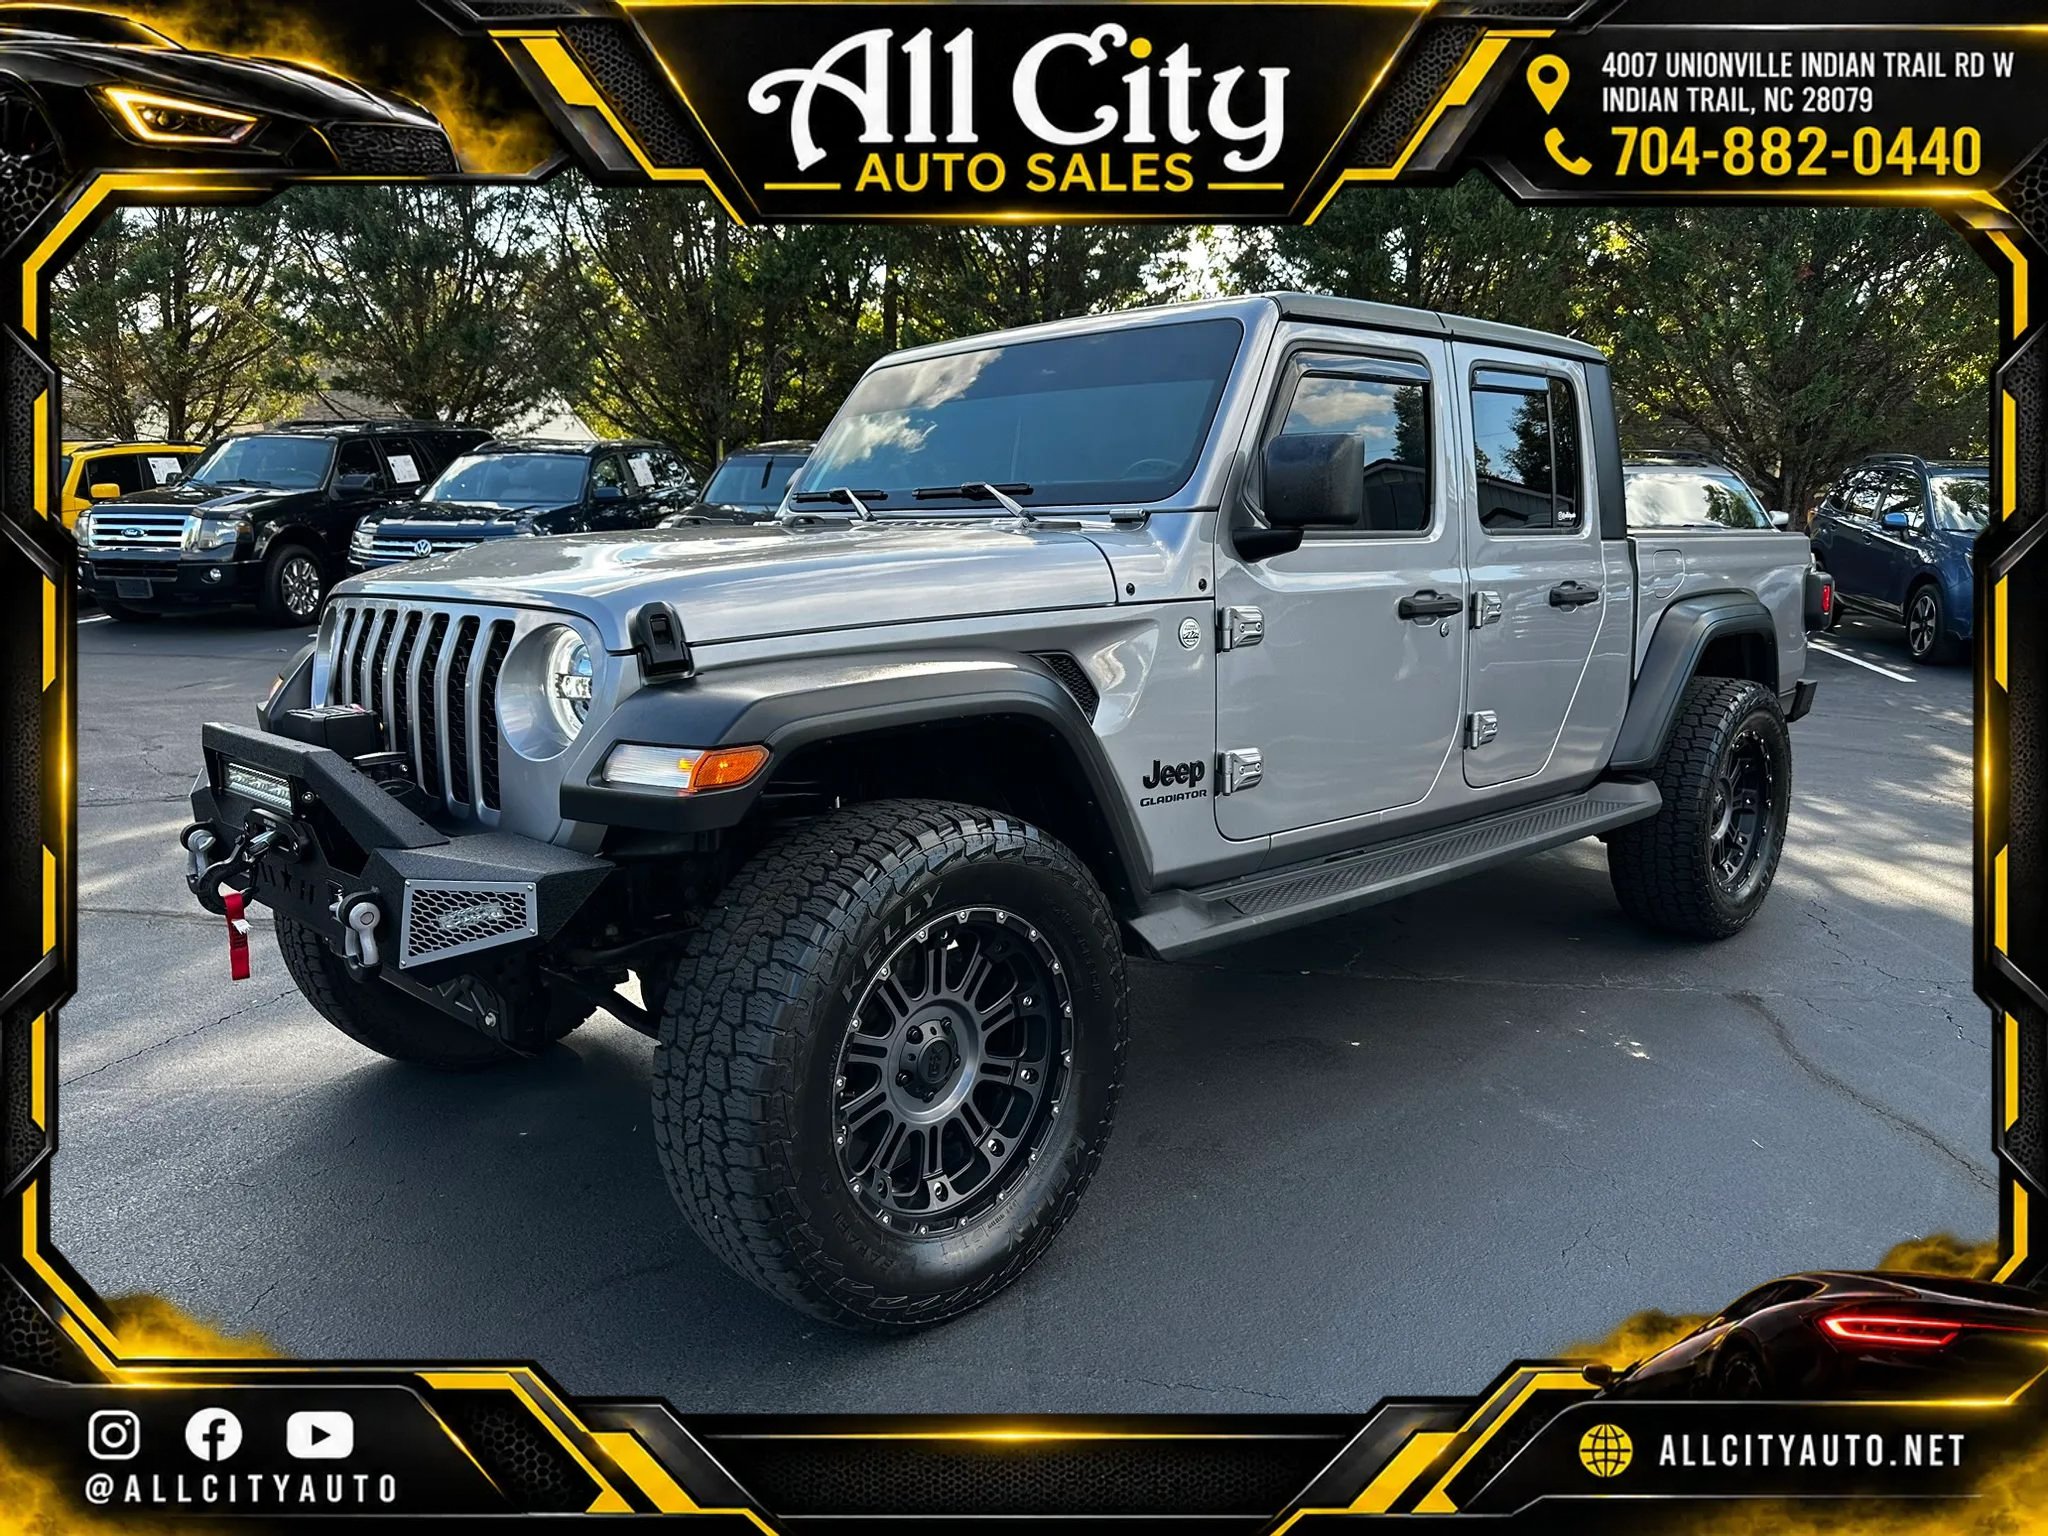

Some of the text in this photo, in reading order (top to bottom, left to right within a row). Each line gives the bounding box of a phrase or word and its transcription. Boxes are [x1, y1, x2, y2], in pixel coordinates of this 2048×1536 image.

[1142, 759, 1205, 789] Jeep
[1139, 789, 1207, 807] GLADIATOR
[842, 881, 943, 1003] KELLY
